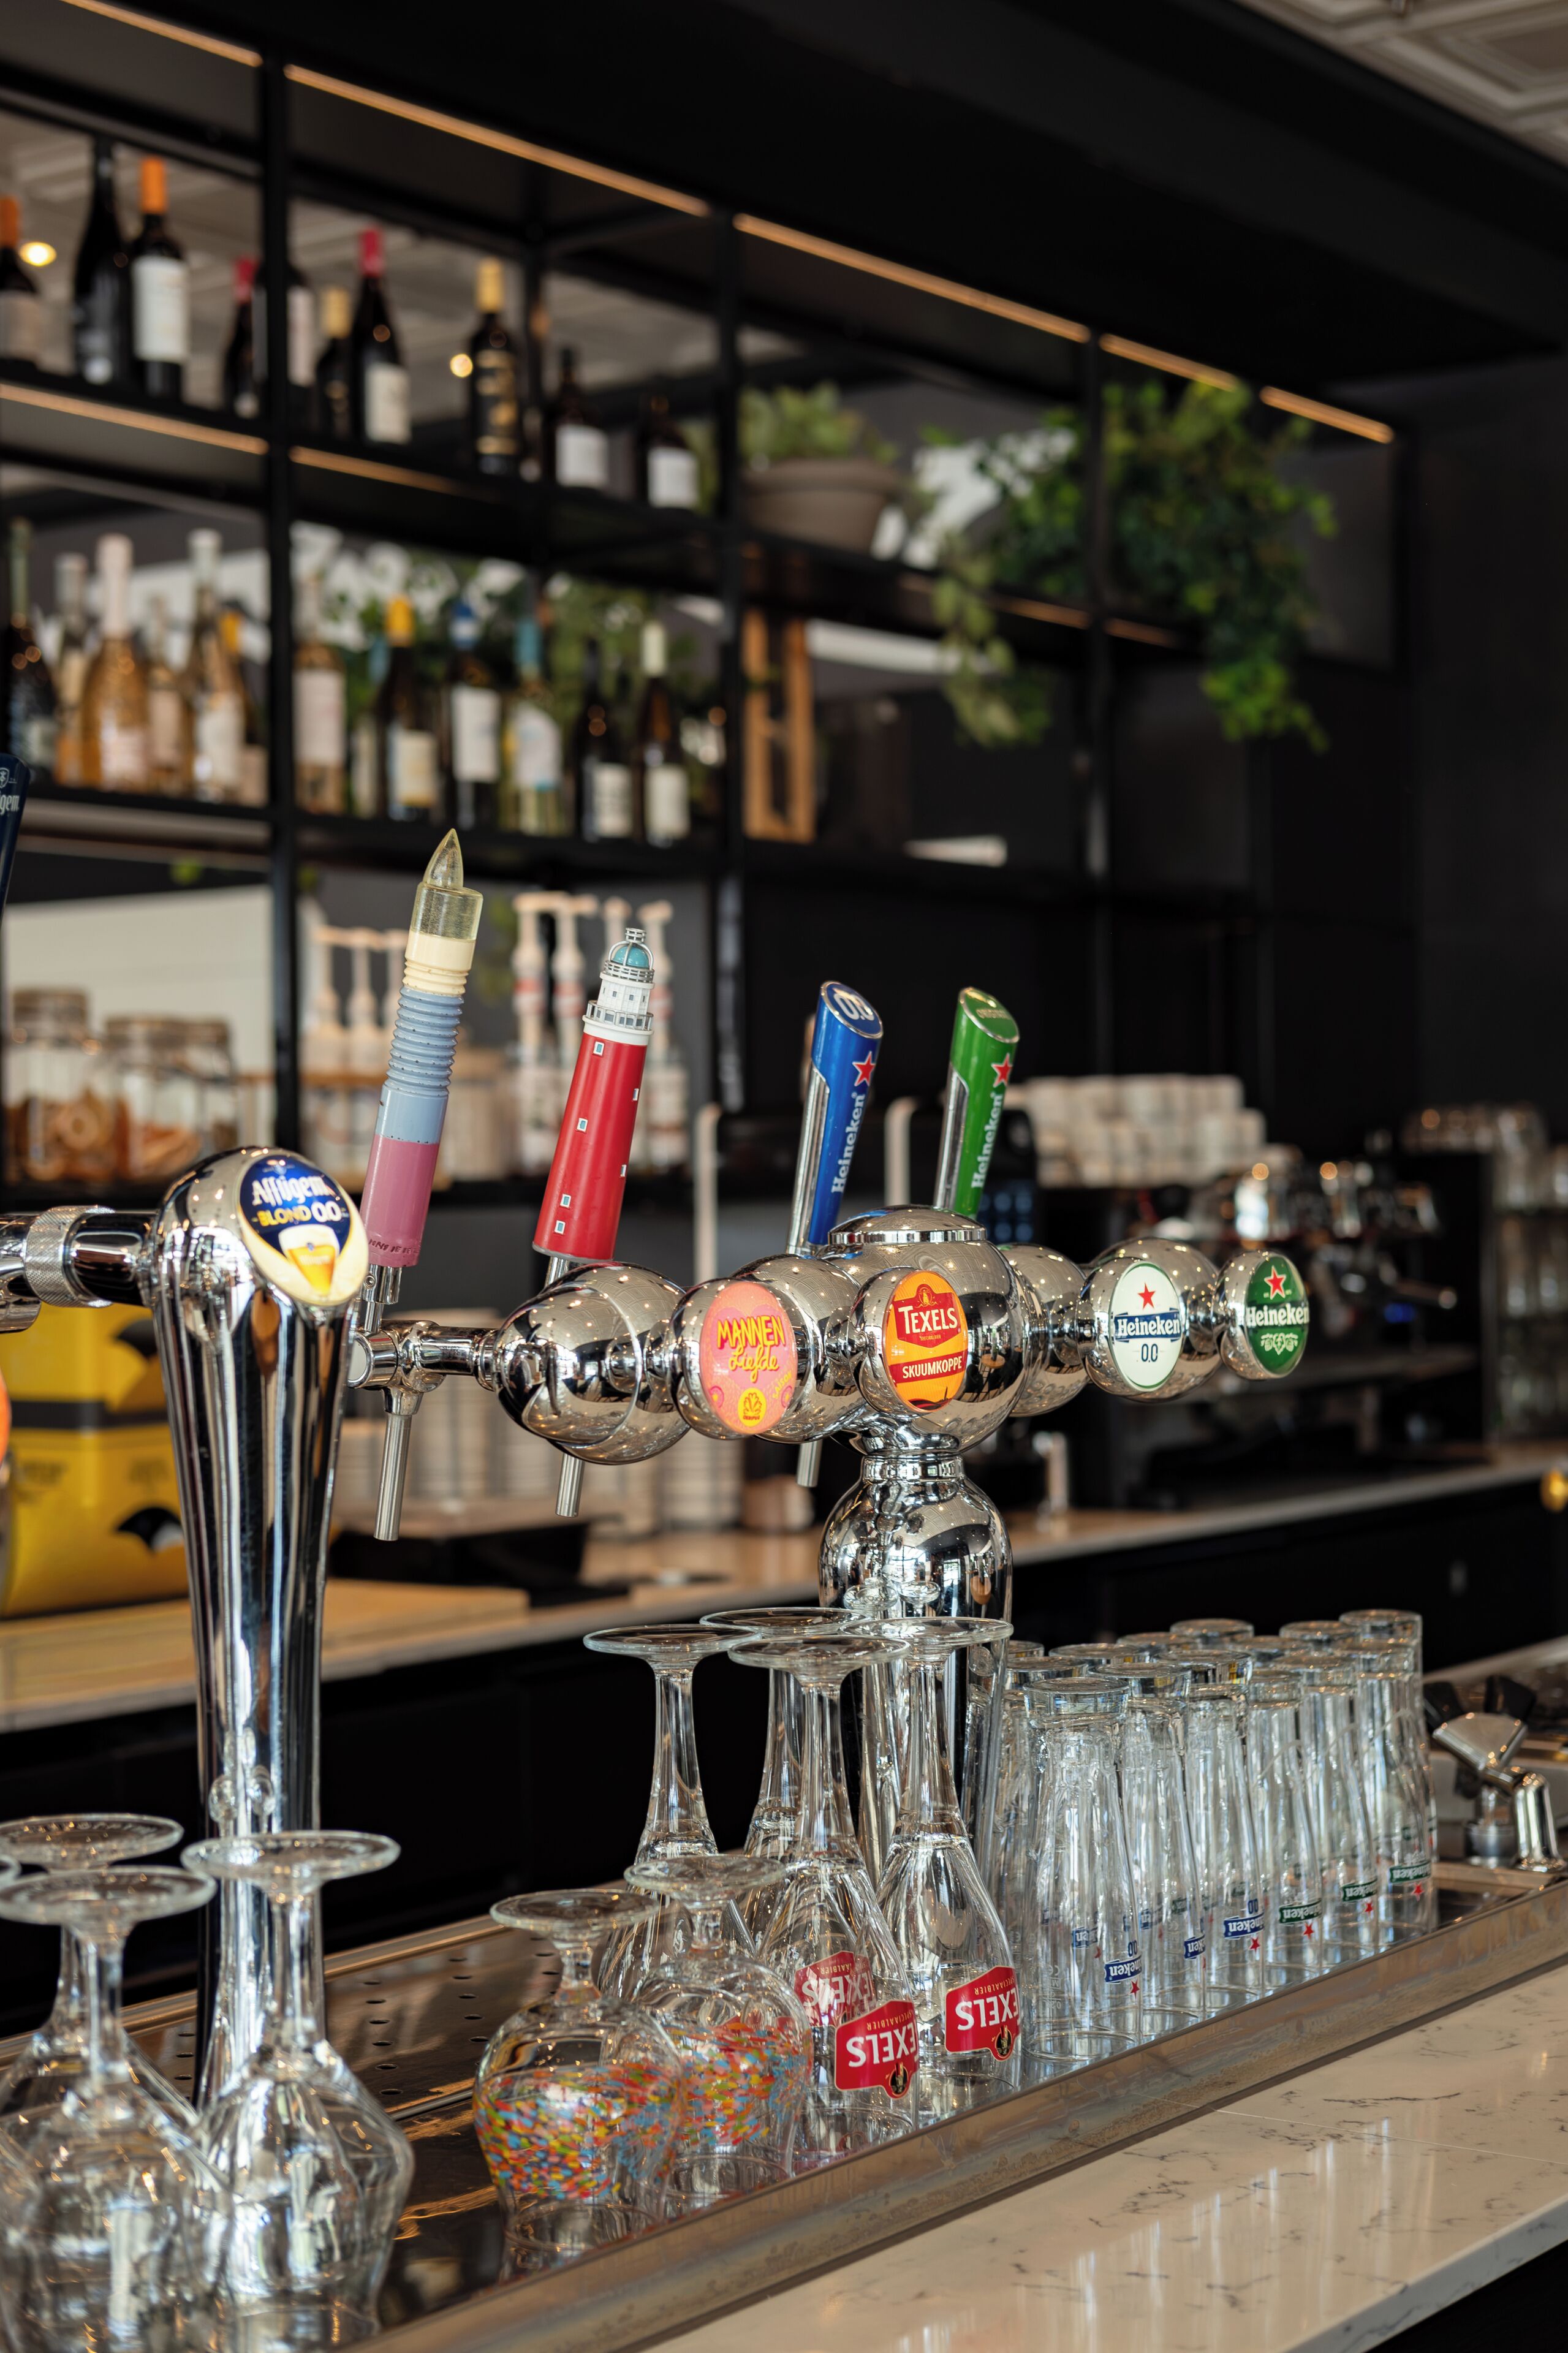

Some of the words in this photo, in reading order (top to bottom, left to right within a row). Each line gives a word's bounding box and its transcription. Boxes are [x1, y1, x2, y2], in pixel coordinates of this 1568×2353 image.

[831, 1094, 865, 1194] Heineken
[971, 1094, 1003, 1188] Heineken
[252, 1175, 331, 1207] Affligem
[257, 1205, 312, 1227] BLOND
[898, 1305, 958, 1335] TEXELS
[1117, 1316, 1181, 1336] Heineken
[1245, 1303, 1309, 1328] Heineken
[717, 1315, 786, 1349] MANNEN
[728, 1345, 780, 1384] Liefde
[1141, 1343, 1158, 1363] 0.0
[902, 1355, 963, 1379] SKUUMKOPPE
[1228, 1920, 1264, 1934] ineken
[1109, 1958, 1142, 1977] ineken
